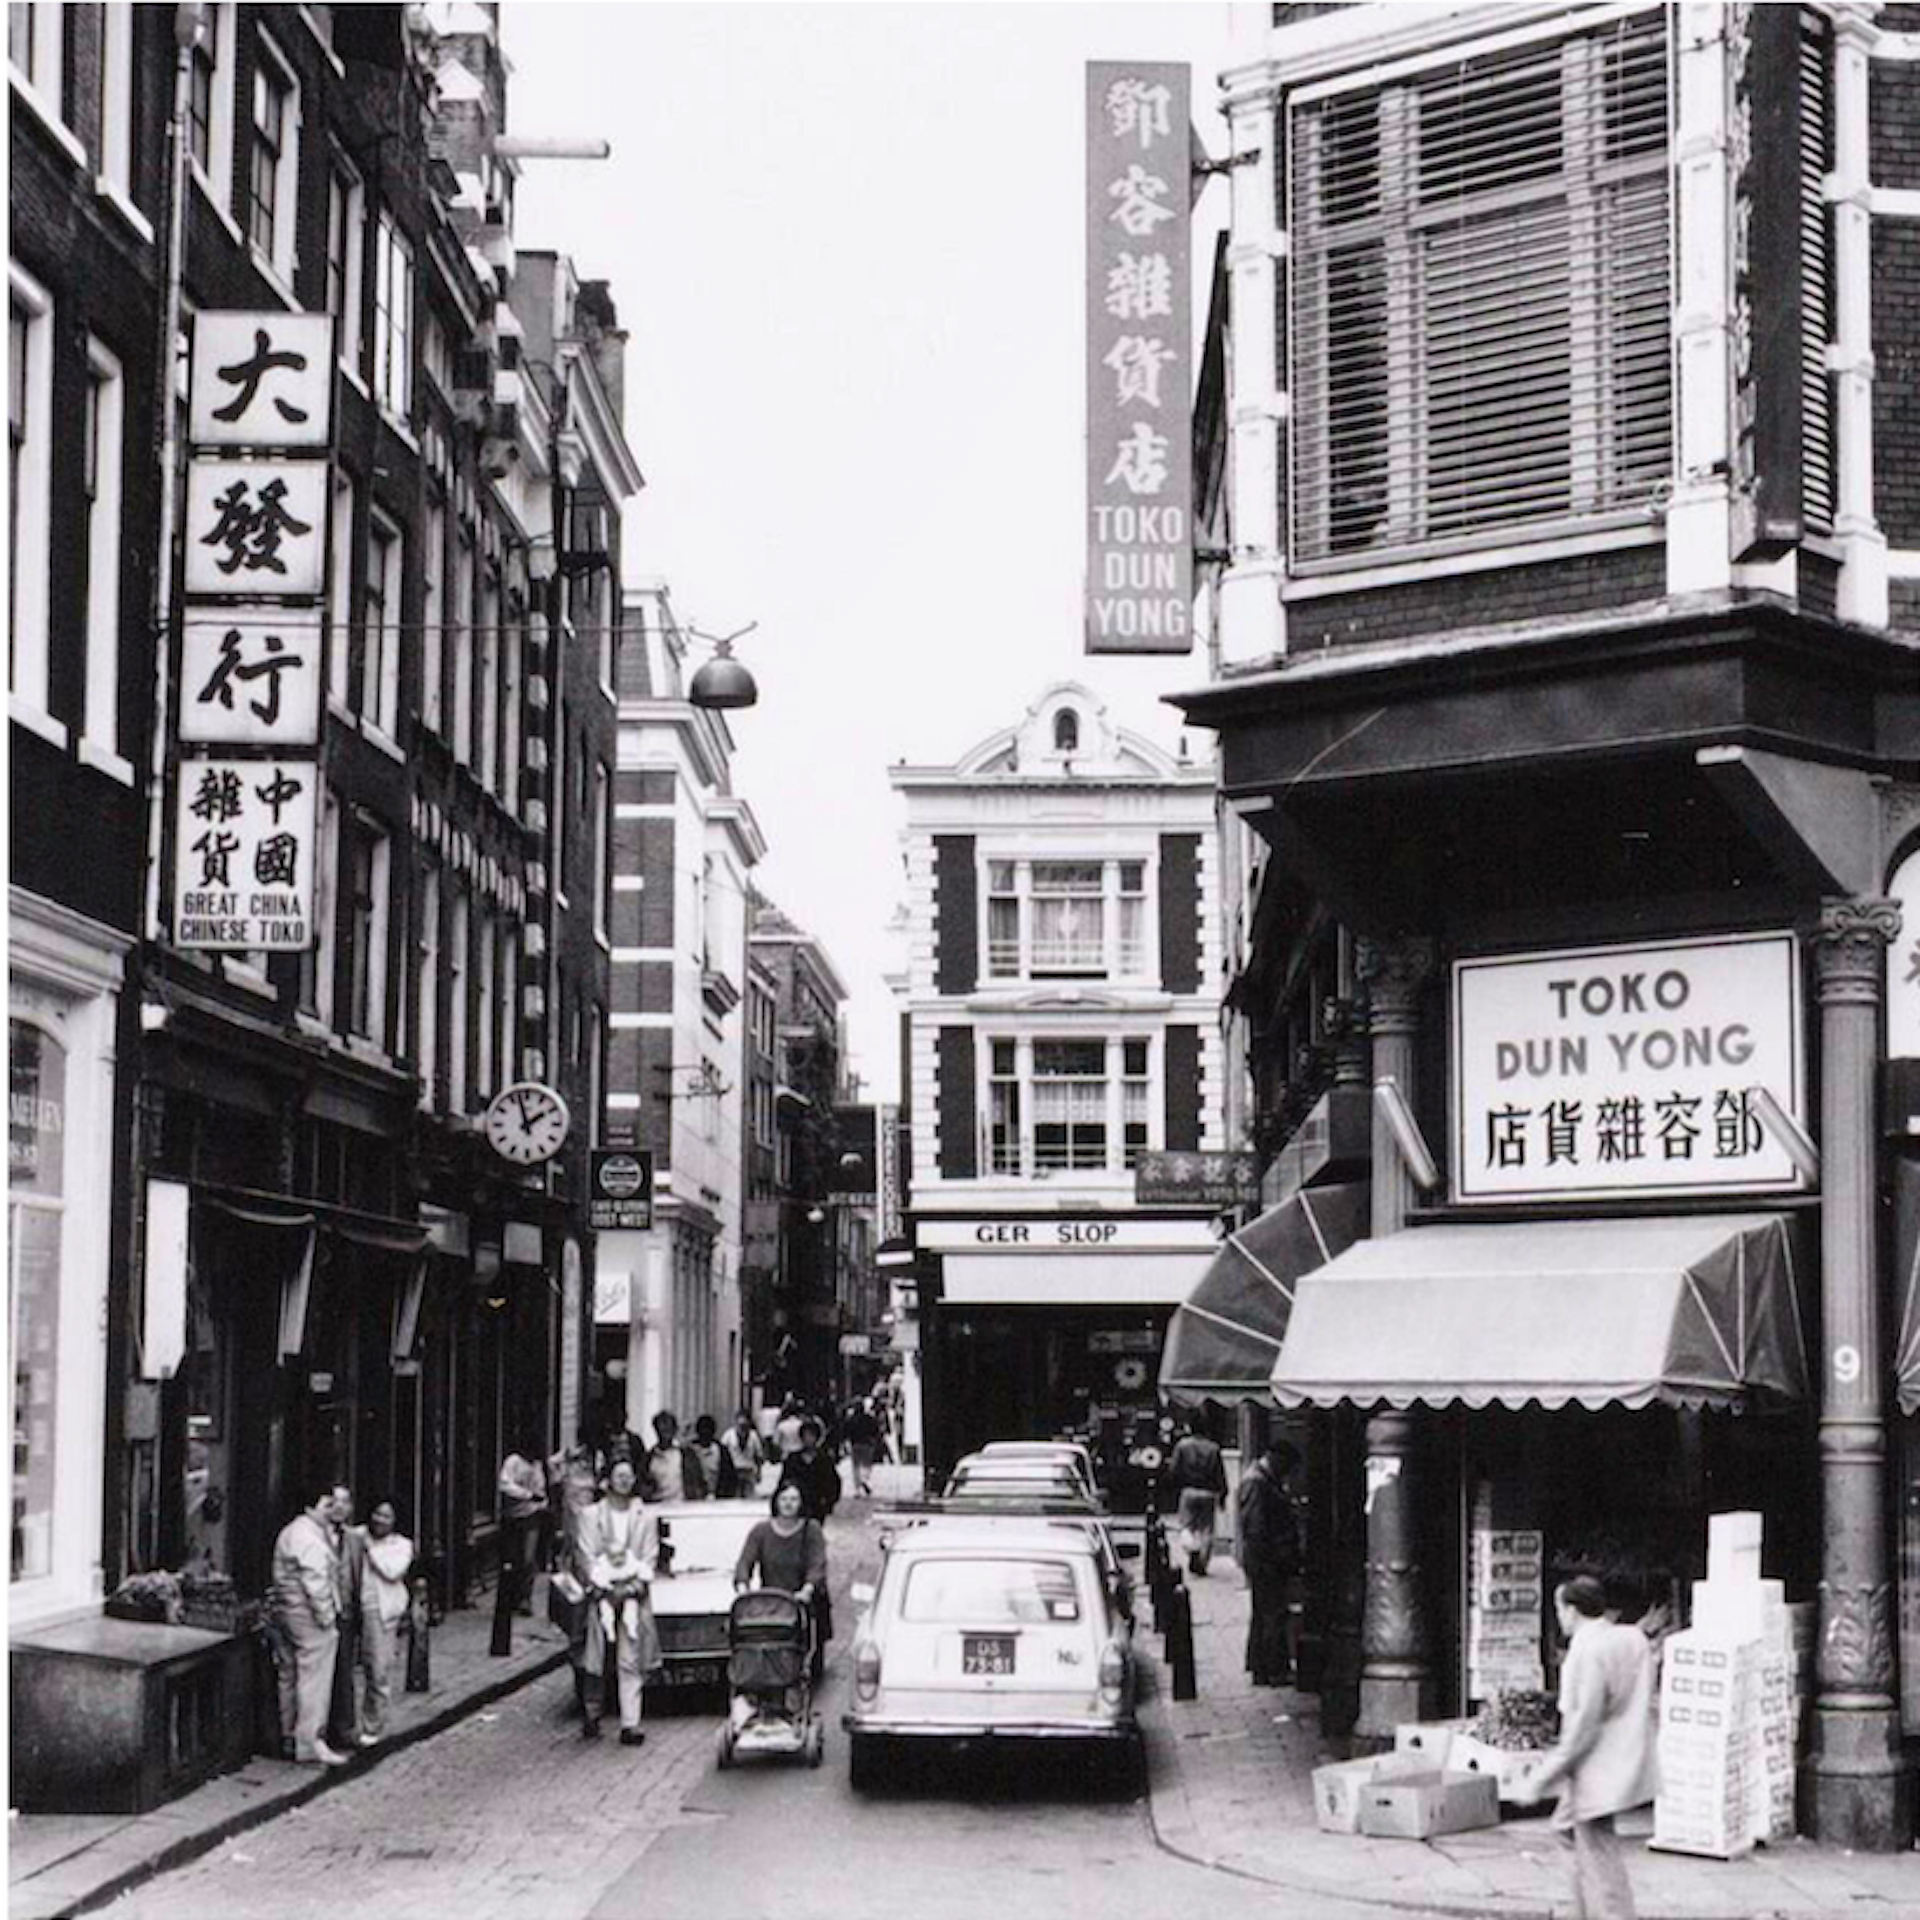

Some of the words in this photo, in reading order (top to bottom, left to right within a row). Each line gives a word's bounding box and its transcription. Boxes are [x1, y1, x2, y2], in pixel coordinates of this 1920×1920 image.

[1093, 505, 1184, 544] TOKO
[1104, 551, 1176, 590] DUN
[1093, 597, 1187, 638] YONG
[184, 892, 238, 916] GREAT
[250, 893, 302, 917] CHINA
[180, 918, 248, 943] CHINESE
[260, 920, 304, 943] TOKO
[1548, 969, 1690, 1019] TOKO
[1496, 1036, 1588, 1081] DUN
[1607, 1023, 1756, 1073] YONG
[976, 1224, 1030, 1244] GER
[1056, 1224, 1118, 1244] SLOP
[1833, 1343, 1861, 1384] 9
